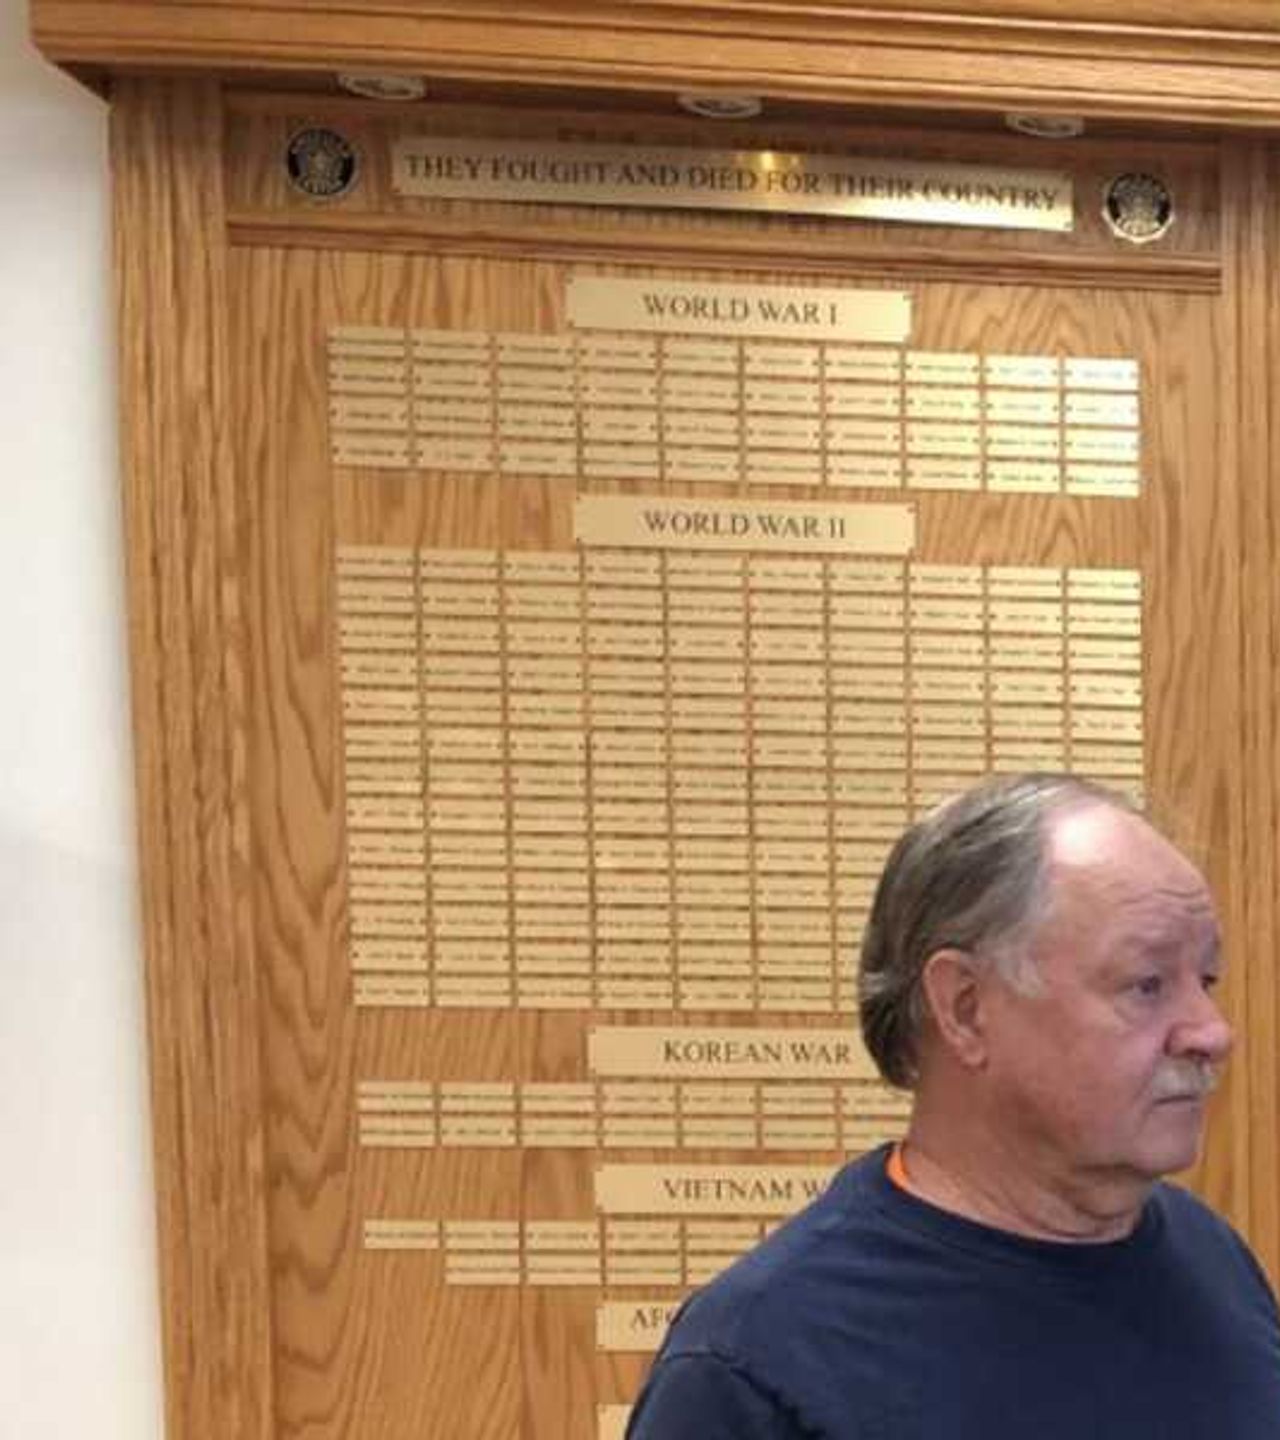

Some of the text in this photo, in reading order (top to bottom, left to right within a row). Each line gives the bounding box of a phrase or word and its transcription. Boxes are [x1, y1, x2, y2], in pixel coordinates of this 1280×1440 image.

[404, 153, 1058, 213] THEY FOUGHT AND DIED FOR THEIR COUNTRY
[641, 292, 838, 327] WORLD WAR I
[643, 509, 846, 540] WORLD WAR II
[663, 1039, 851, 1065] KOREAN WAR
[661, 1178, 793, 1201] VIETNAM
